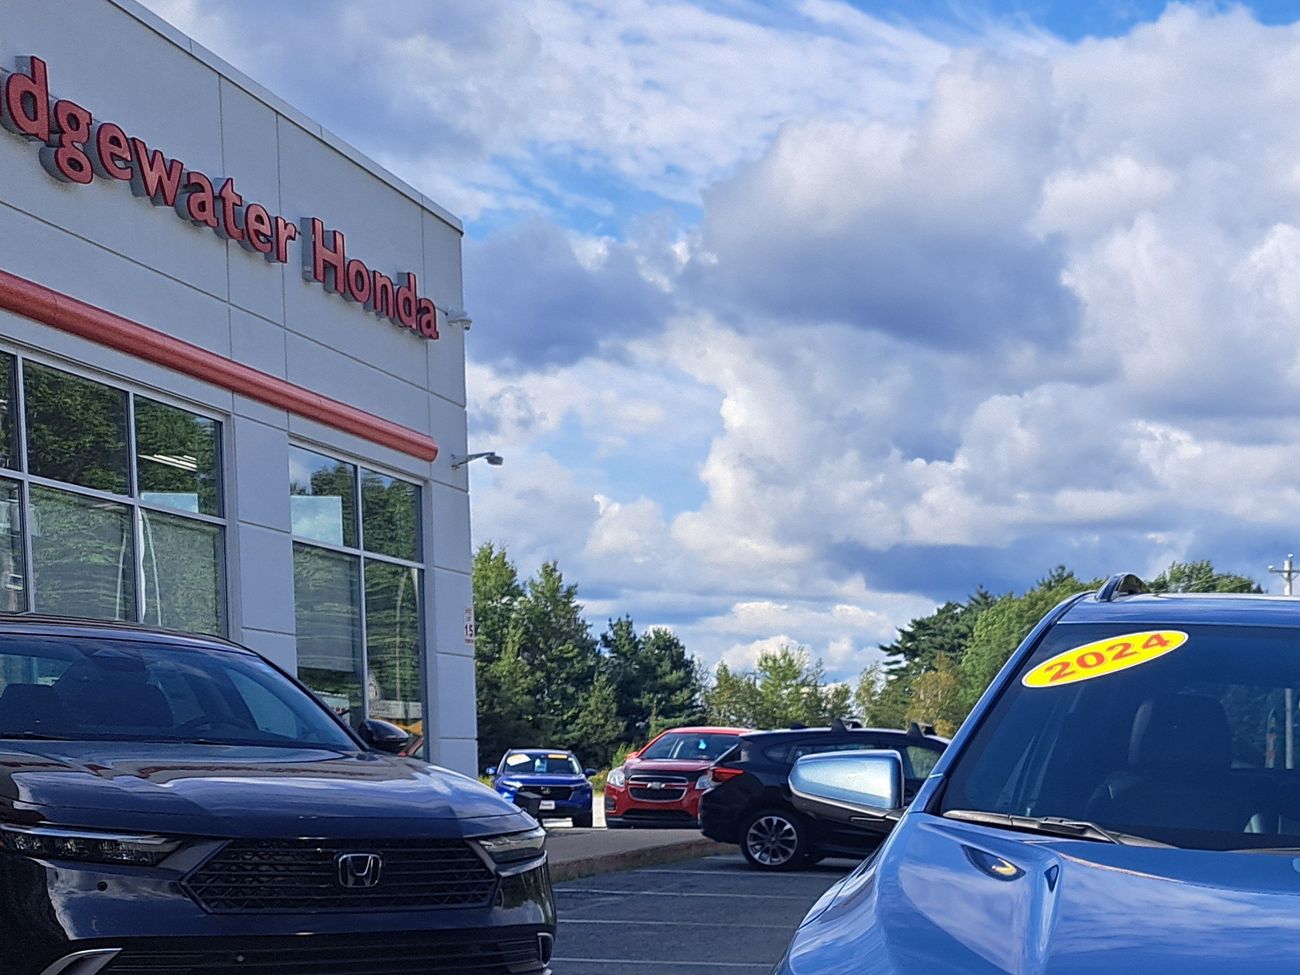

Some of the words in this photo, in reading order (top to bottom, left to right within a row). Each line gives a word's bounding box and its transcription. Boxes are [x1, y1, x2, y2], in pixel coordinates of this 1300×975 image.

[0, 55, 297, 264] dgewater
[311, 217, 440, 341] Honda
[1044, 633, 1173, 682] 2024
